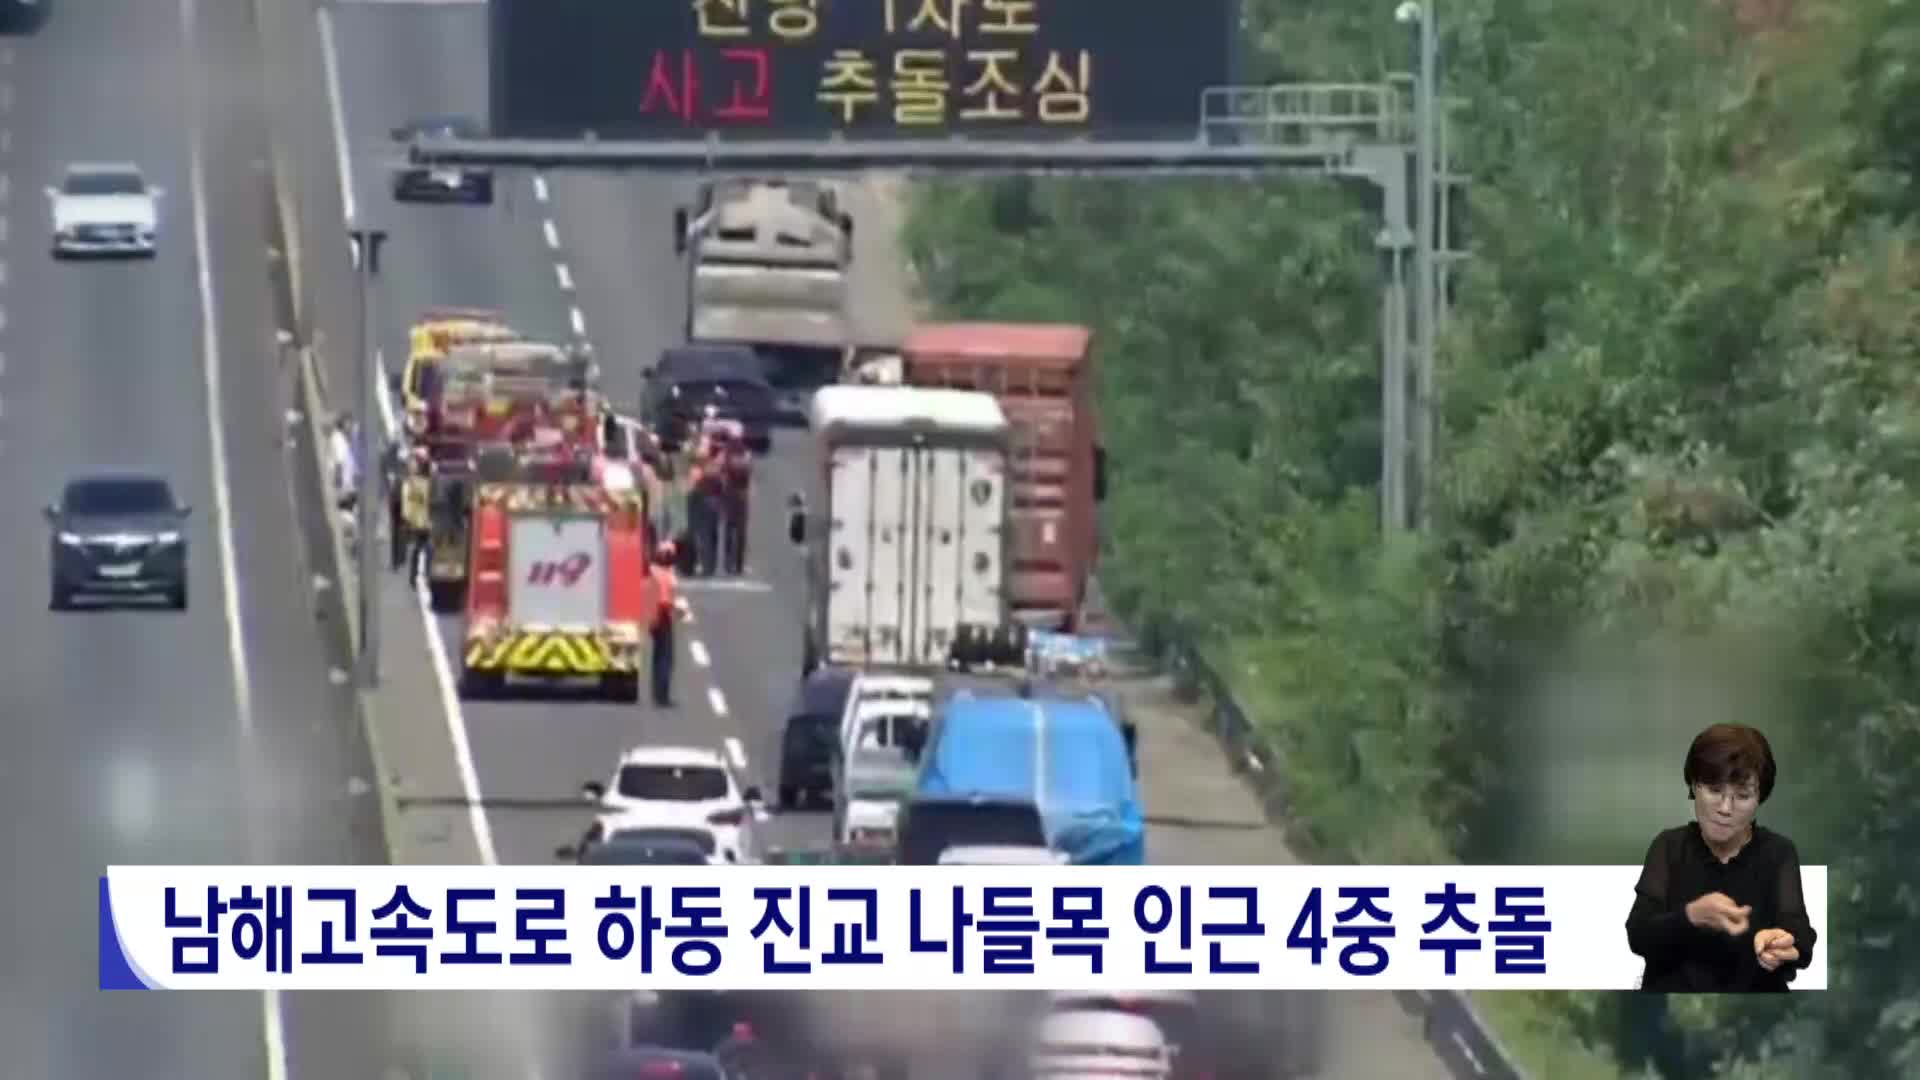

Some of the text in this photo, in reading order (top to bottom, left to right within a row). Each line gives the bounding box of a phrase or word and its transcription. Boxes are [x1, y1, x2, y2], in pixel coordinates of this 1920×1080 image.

[641, 49, 1092, 124] 사고 추돌조심
[528, 552, 591, 586] 119
